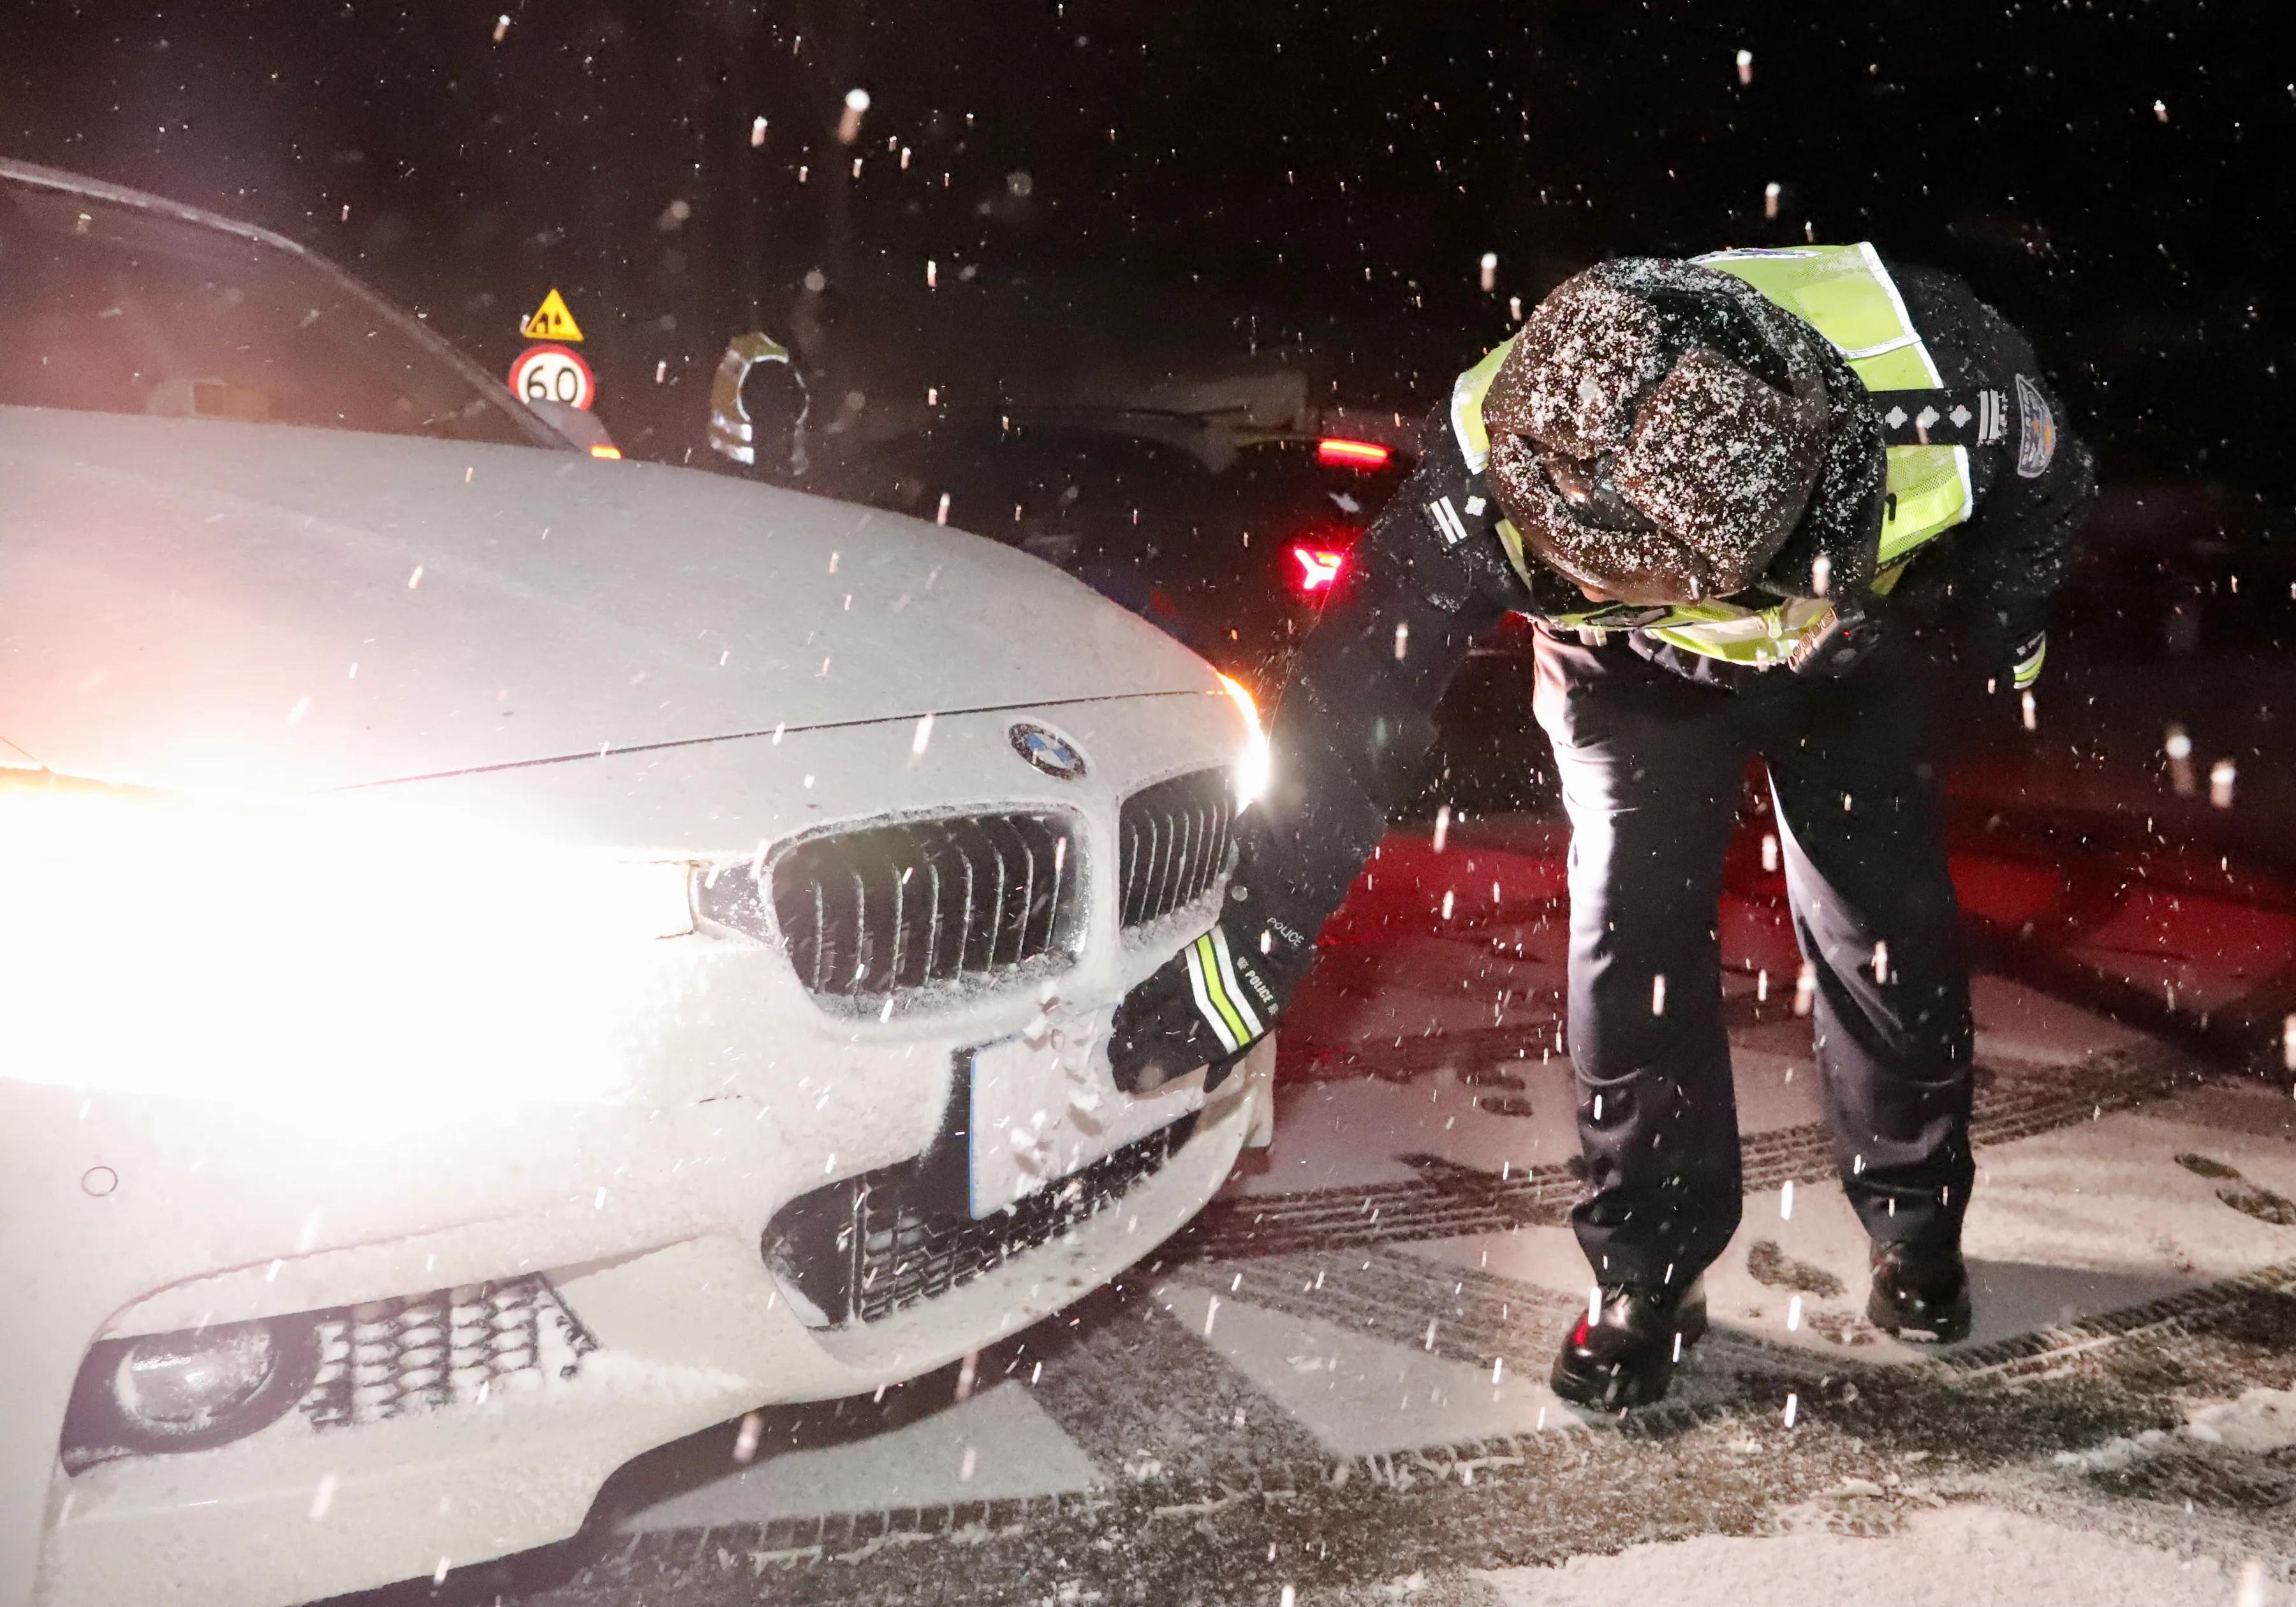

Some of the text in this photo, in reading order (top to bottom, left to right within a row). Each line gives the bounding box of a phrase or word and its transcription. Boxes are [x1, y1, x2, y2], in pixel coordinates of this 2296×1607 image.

[527, 365, 577, 402] 60
[1267, 917, 1304, 946] POLICE
[1245, 970, 1274, 1003] POLICE
